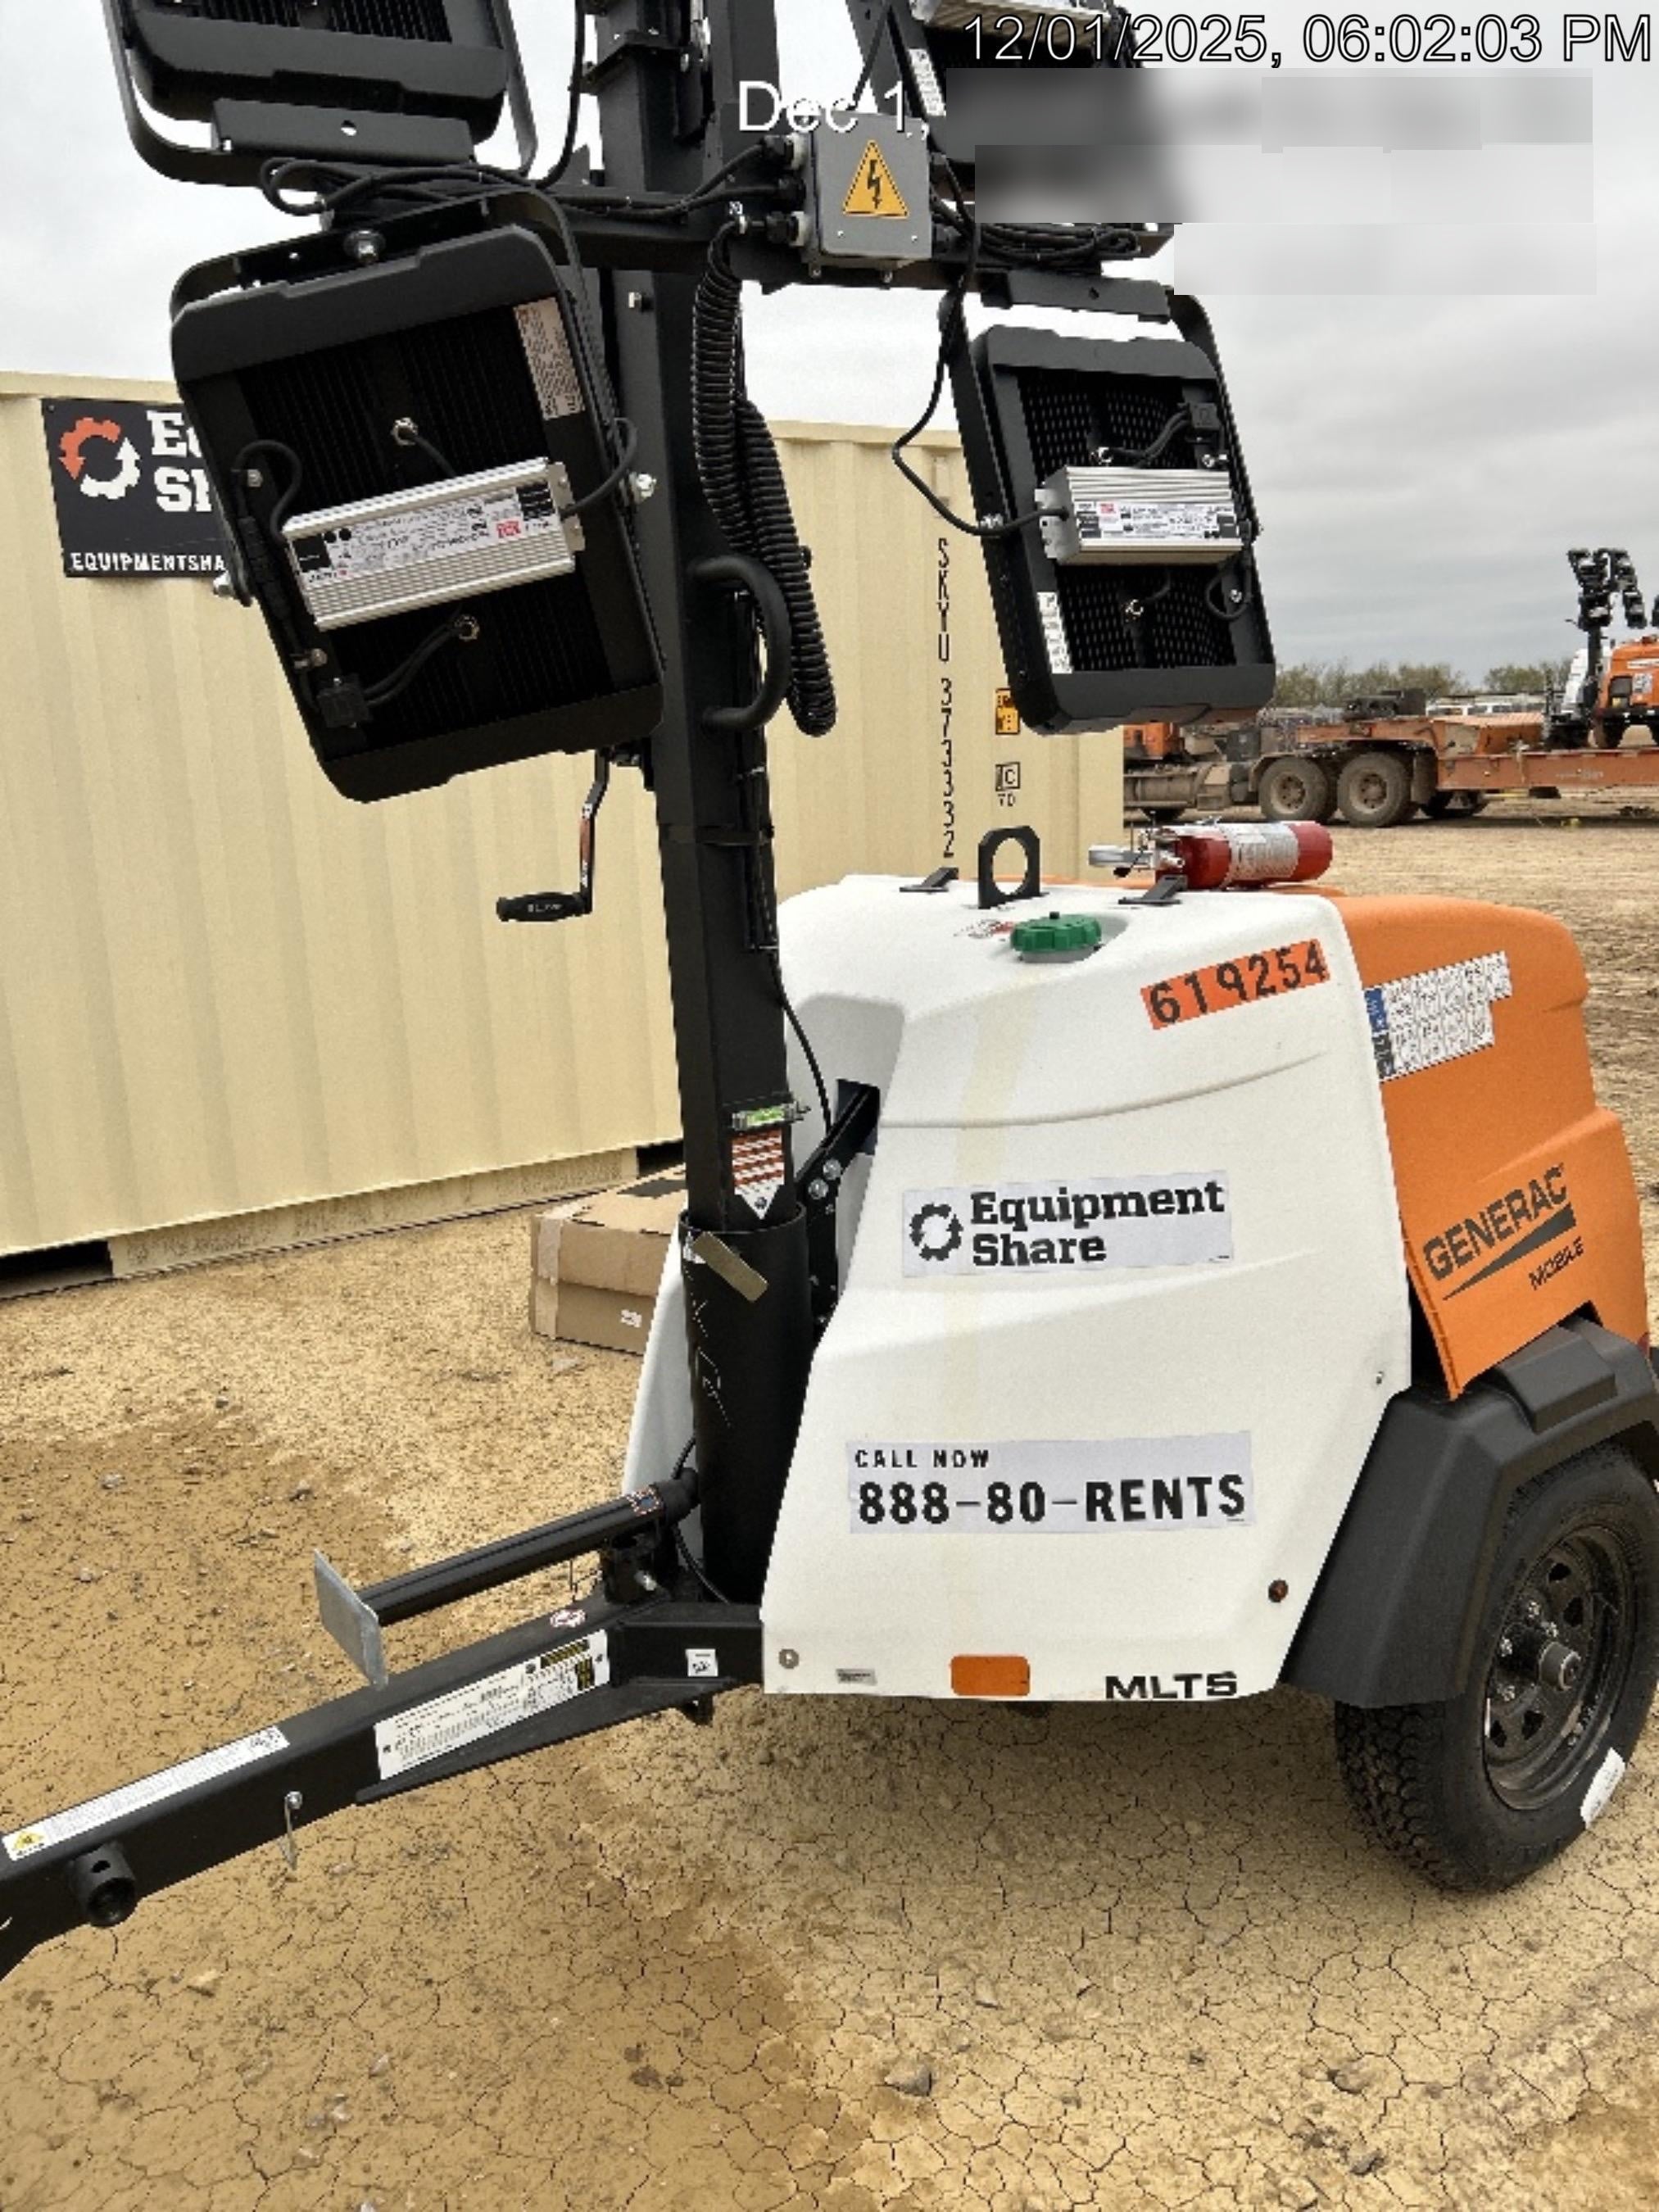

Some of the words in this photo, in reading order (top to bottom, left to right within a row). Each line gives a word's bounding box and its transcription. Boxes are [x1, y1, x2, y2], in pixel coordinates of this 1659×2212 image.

[1149, 941, 1329, 1024] 619254
[970, 1181, 1225, 1231] Equipment
[1423, 1166, 1567, 1281] GENERAC
[972, 1233, 1107, 1267] Share
[1529, 1236, 1585, 1290] MOBILE
[854, 1449, 918, 1469] CALL
[932, 1449, 990, 1468] NOW
[858, 1474, 1246, 1525] 888-80-RENTS
[1105, 1671, 1238, 1701] MLTS
